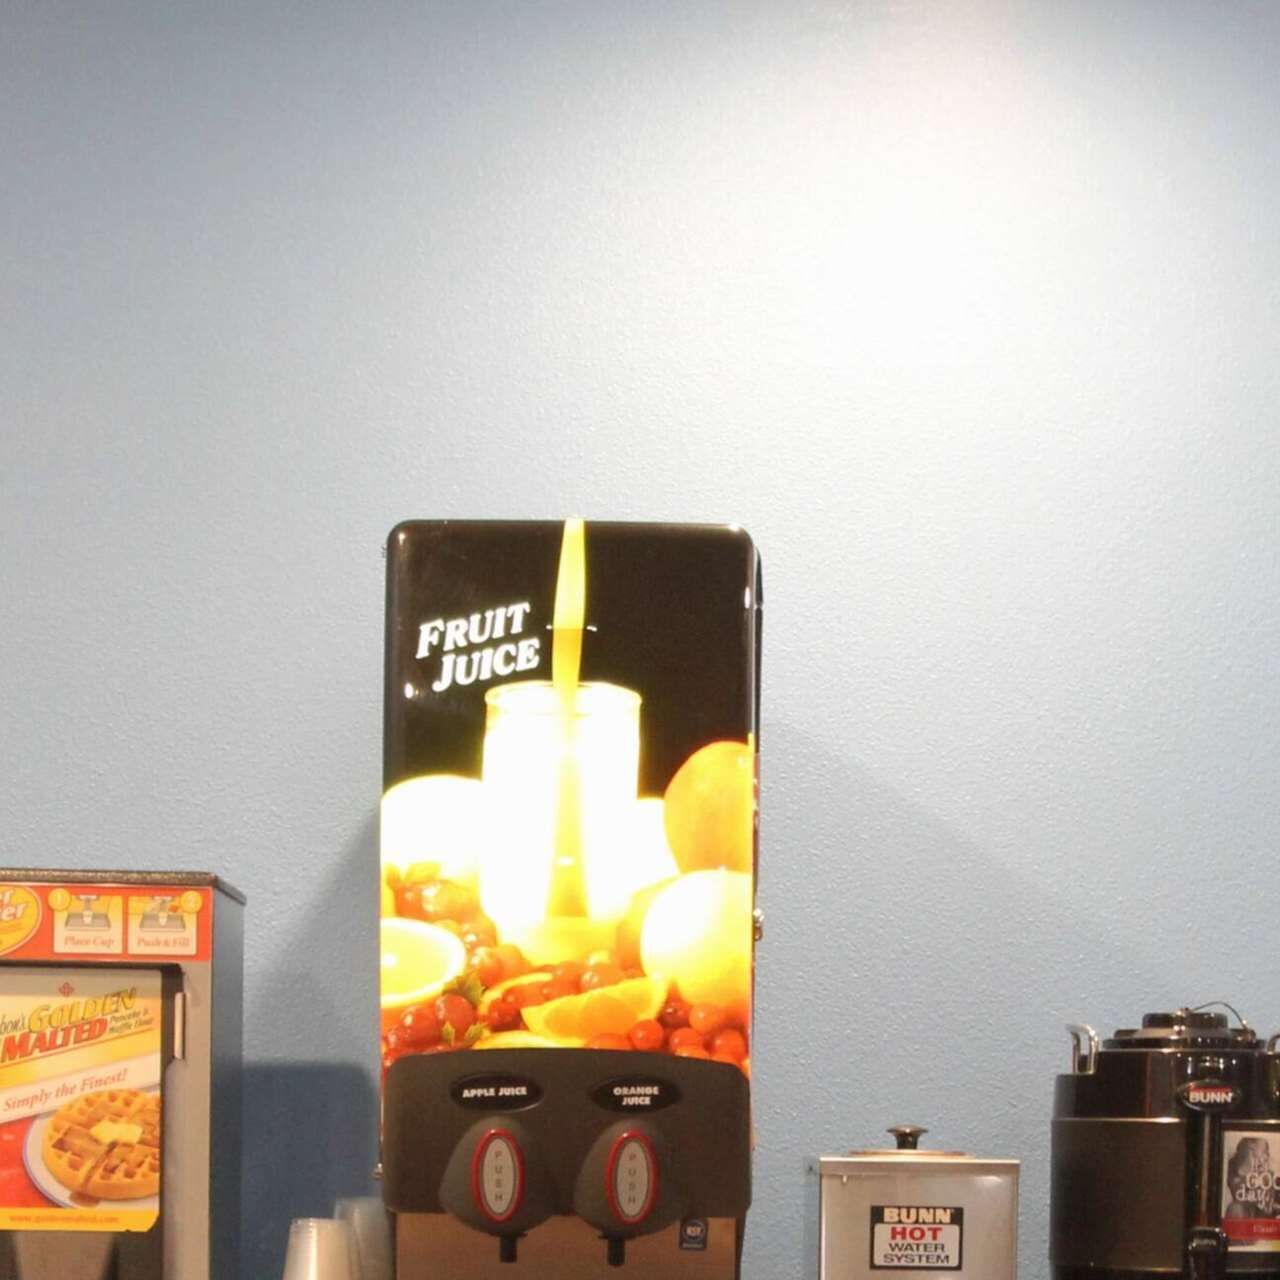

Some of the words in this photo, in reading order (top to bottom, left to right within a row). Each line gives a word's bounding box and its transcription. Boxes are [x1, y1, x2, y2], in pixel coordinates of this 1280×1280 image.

[415, 602, 531, 659] FRUIT
[432, 637, 540, 692] JUICE
[64, 935, 91, 946] Place
[93, 935, 114, 949] Cup
[28, 987, 136, 1034] GOLDEN
[0, 1018, 108, 1063] MALTED
[3, 1089, 52, 1112] Simply
[55, 1082, 77, 1098] the
[80, 1068, 128, 1092] Finest!
[462, 1088, 495, 1098] APPLE
[498, 1087, 527, 1096] JUICE
[613, 1086, 659, 1096] ORANGE
[1189, 1090, 1233, 1103] BUNN
[622, 1096, 651, 1105] JUICE
[884, 1207, 951, 1223] BUNN
[890, 1226, 942, 1241] HOT
[888, 1242, 946, 1252] WATER
[883, 1253, 950, 1264] SYSTEM
